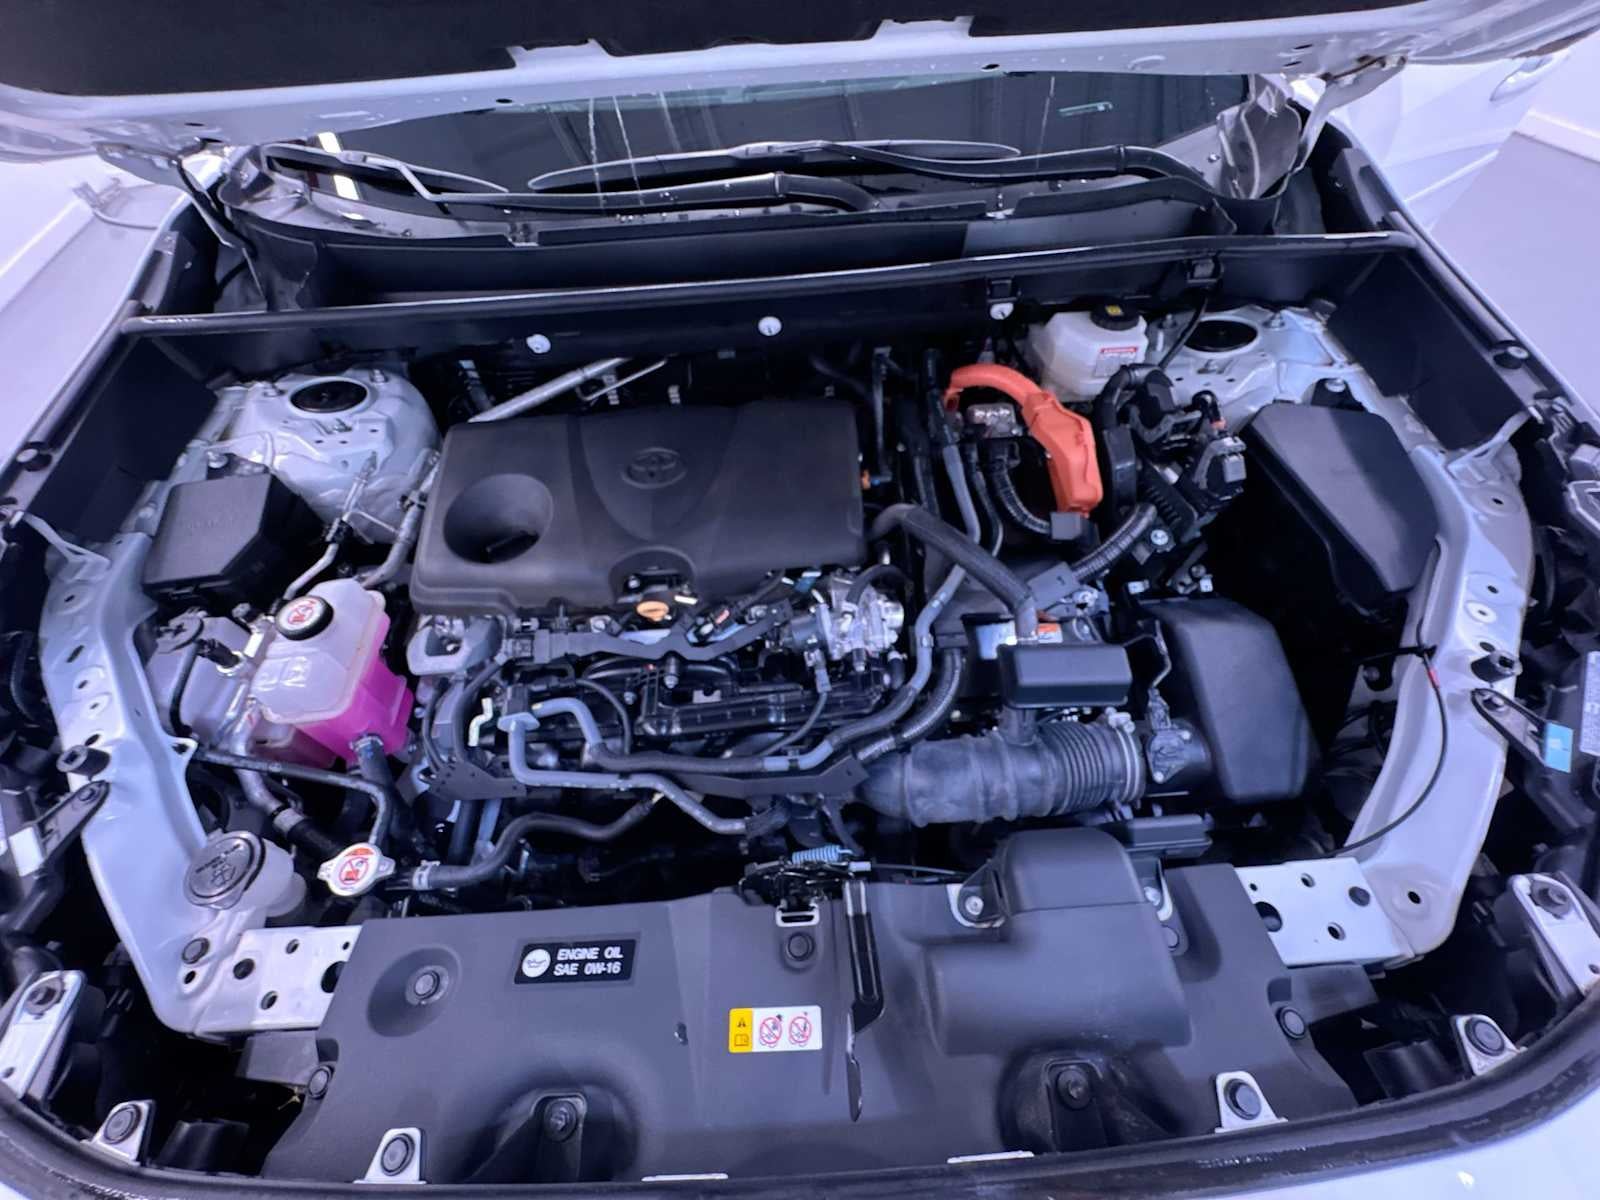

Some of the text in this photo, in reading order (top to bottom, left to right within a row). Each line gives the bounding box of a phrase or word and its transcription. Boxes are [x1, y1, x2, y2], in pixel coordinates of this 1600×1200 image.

[556, 946, 624, 961] ENGINE OIL
[553, 961, 622, 976] SAE 0W-16
